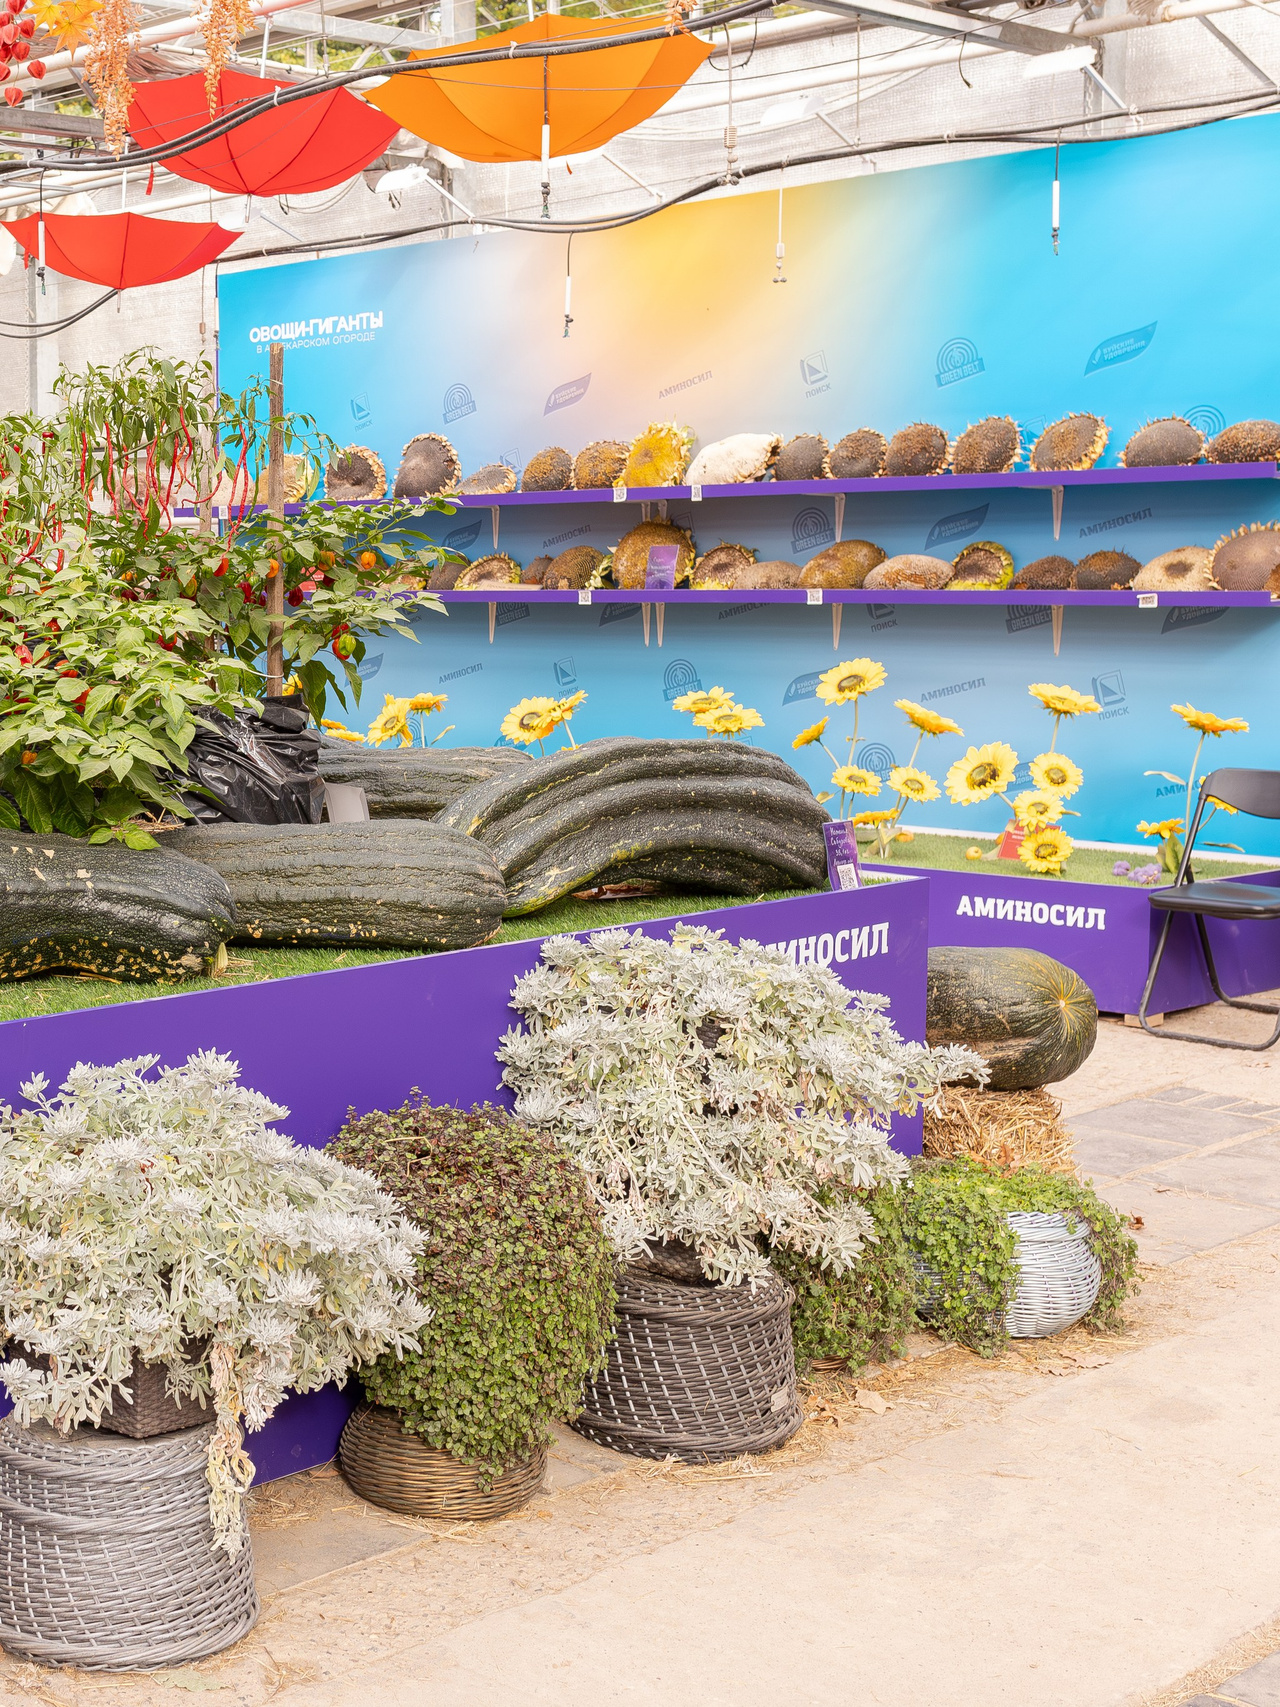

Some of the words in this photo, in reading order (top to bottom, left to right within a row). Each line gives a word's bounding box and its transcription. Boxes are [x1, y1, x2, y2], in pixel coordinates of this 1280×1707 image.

[249, 310, 383, 343] ОВОЩИ-ГИГАНТЫ
[256, 344, 263, 354] В
[264, 337, 330, 353] АЕКАРСКОМ
[332, 331, 376, 345] ОГОРОДЕ
[658, 370, 713, 399] АМИНОСИЛ
[940, 368, 963, 386] GREEN
[962, 361, 981, 377] BELT
[805, 382, 832, 399] ПОИСК
[1079, 507, 1153, 538] АМИНОСИЛ
[542, 524, 592, 549] АМИНОСИЛ
[795, 536, 817, 551] GREEN
[815, 530, 832, 546] BELT
[871, 618, 898, 633] ПОИСК
[1011, 615, 1036, 631] GREEN
[438, 662, 483, 684] АМИНОСИЛ
[558, 685, 579, 699] ПОИСК
[920, 677, 986, 703] АМИНОСИЛ
[1098, 706, 1129, 721] ПОИСК
[956, 895, 1106, 930] АМИНОСИЛ
[764, 922, 889, 969] ИНОСИЛ
